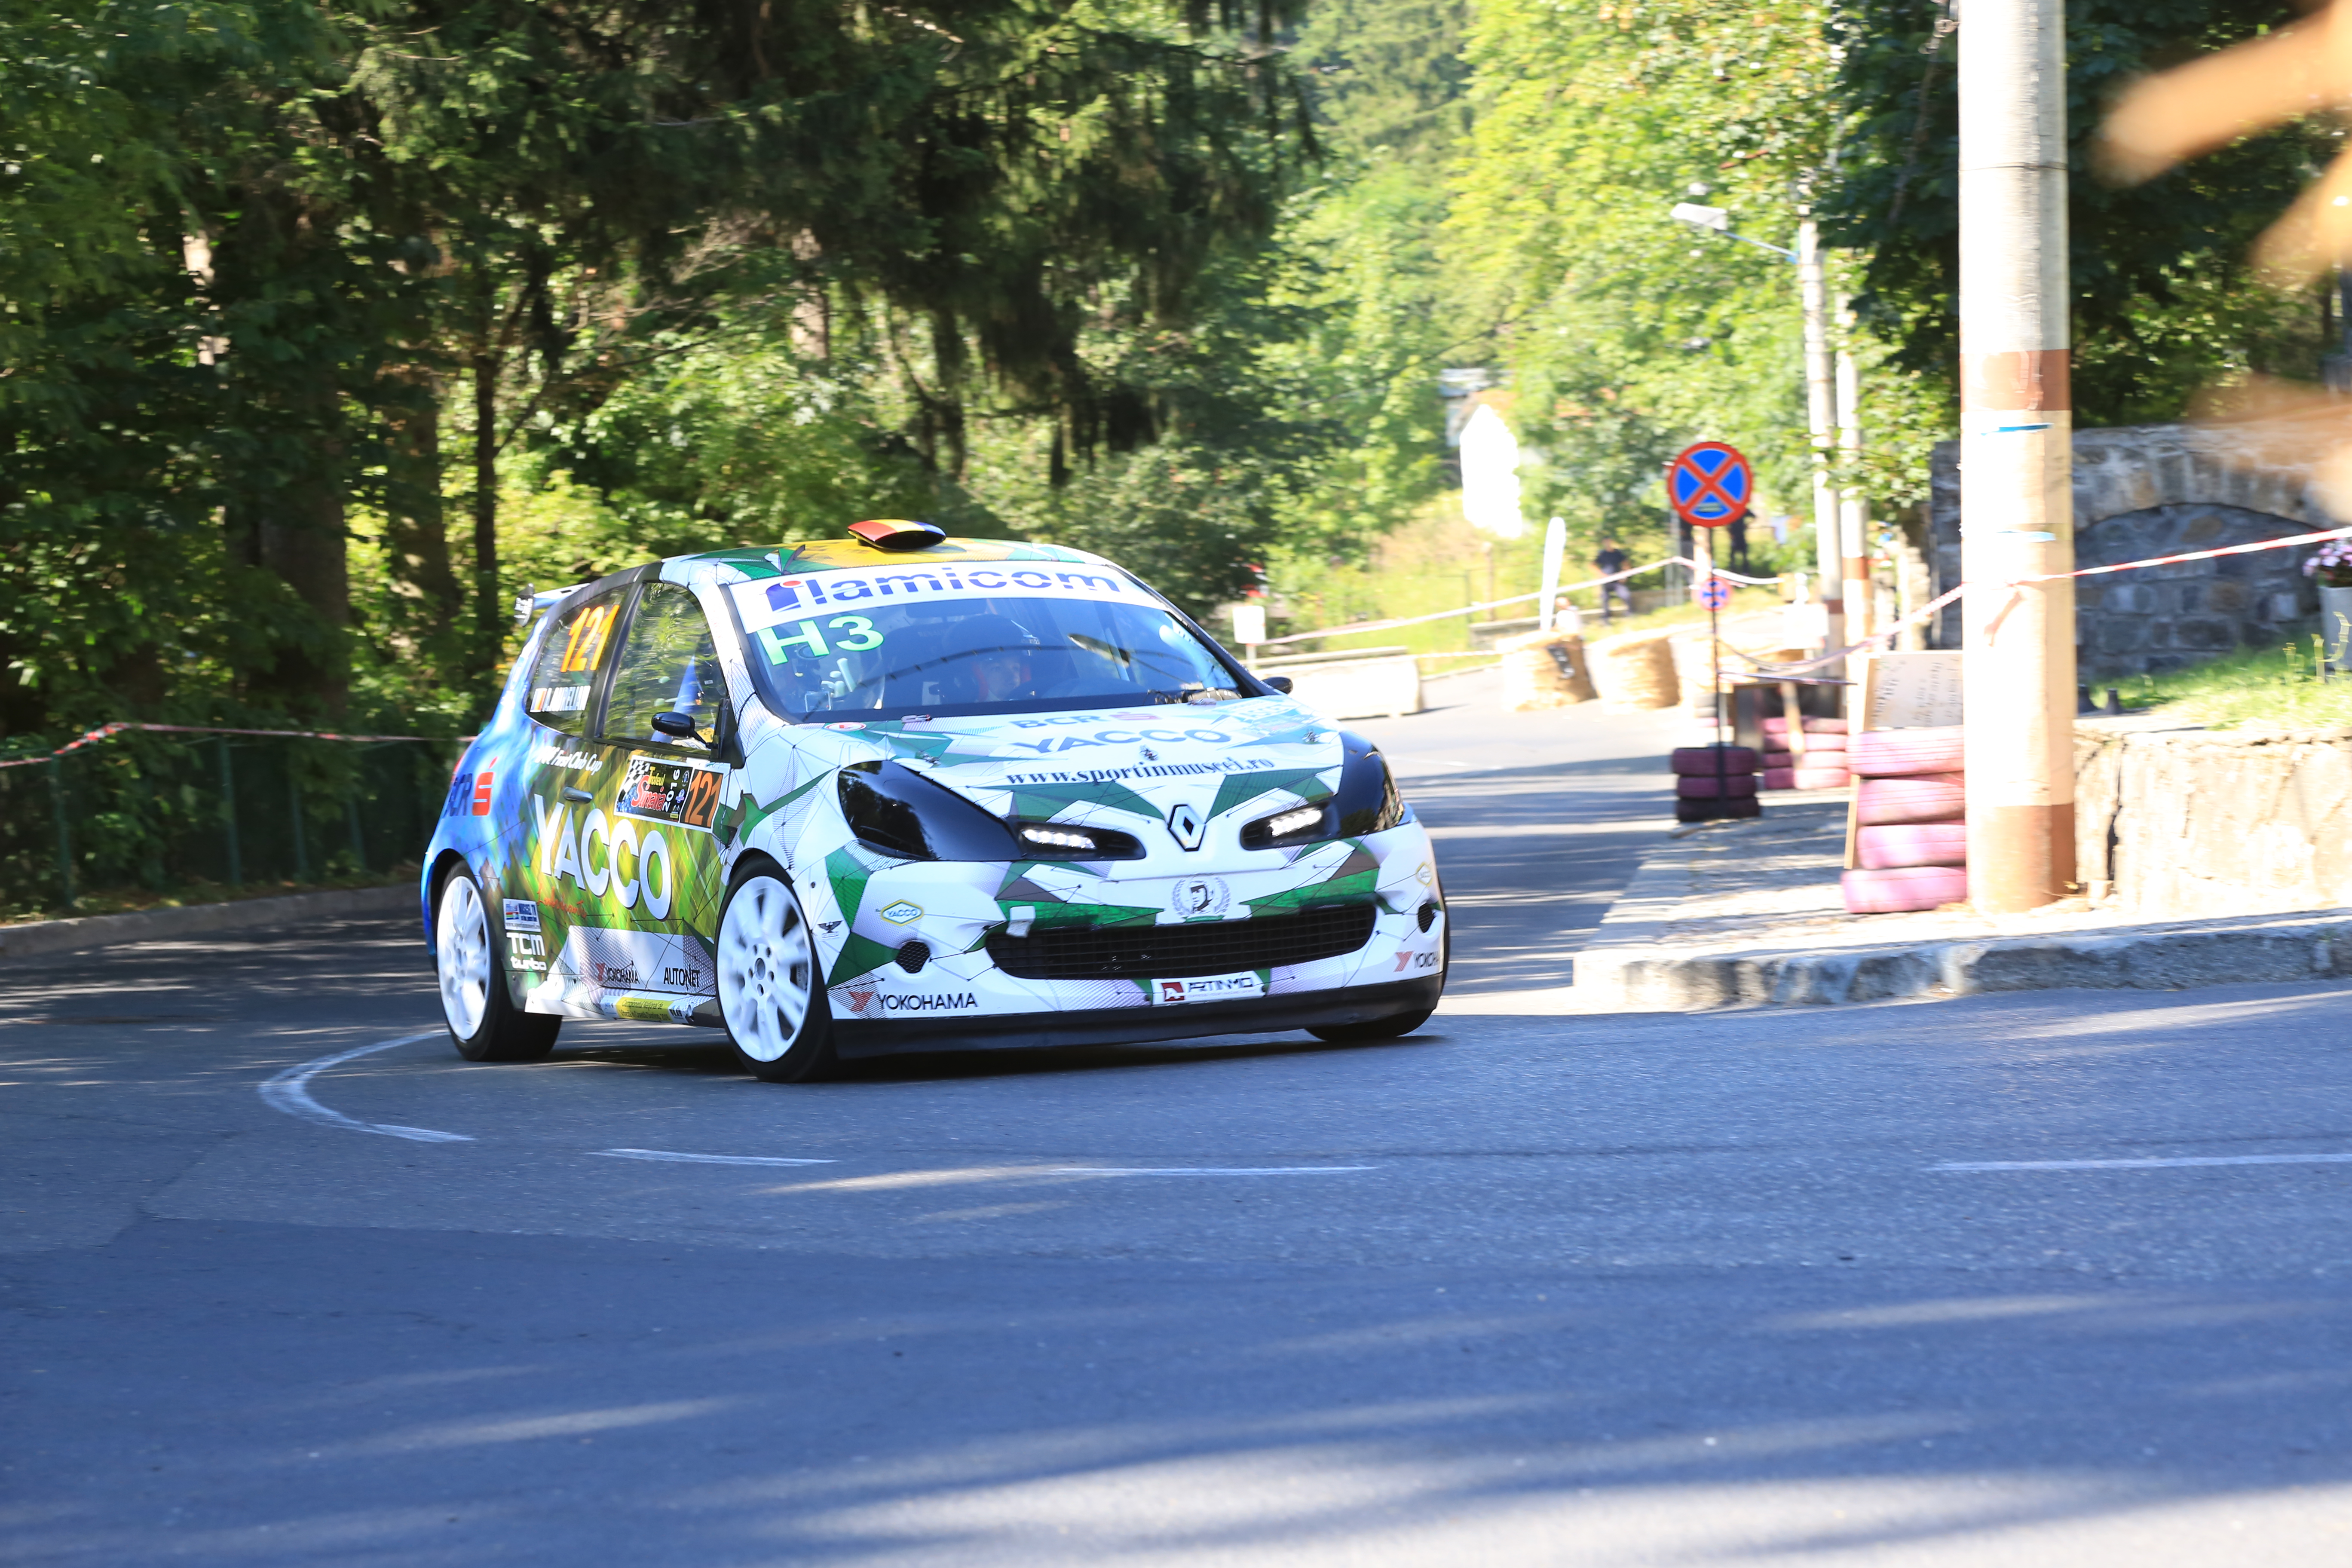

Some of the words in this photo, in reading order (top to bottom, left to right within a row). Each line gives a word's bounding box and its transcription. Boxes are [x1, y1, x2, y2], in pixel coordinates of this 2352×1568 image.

[560, 604, 620, 673] 121
[756, 615, 884, 666] H3
[1009, 715, 1102, 728] BCR
[1008, 729, 1232, 753] YACCO
[567, 751, 589, 770] Club
[585, 753, 603, 776] Cup
[648, 766, 666, 787] Trofeul
[631, 774, 666, 811] Sinaia
[662, 769, 681, 812] 2016
[684, 770, 723, 827] 121
[534, 793, 672, 922] YACCO
[886, 908, 917, 917] YACCO
[506, 932, 546, 956] TCM
[510, 956, 547, 971] turbo
[606, 967, 641, 985] YOKOHAMA
[663, 966, 701, 988] AUTONET
[879, 992, 978, 1010] YOKOHAMA
